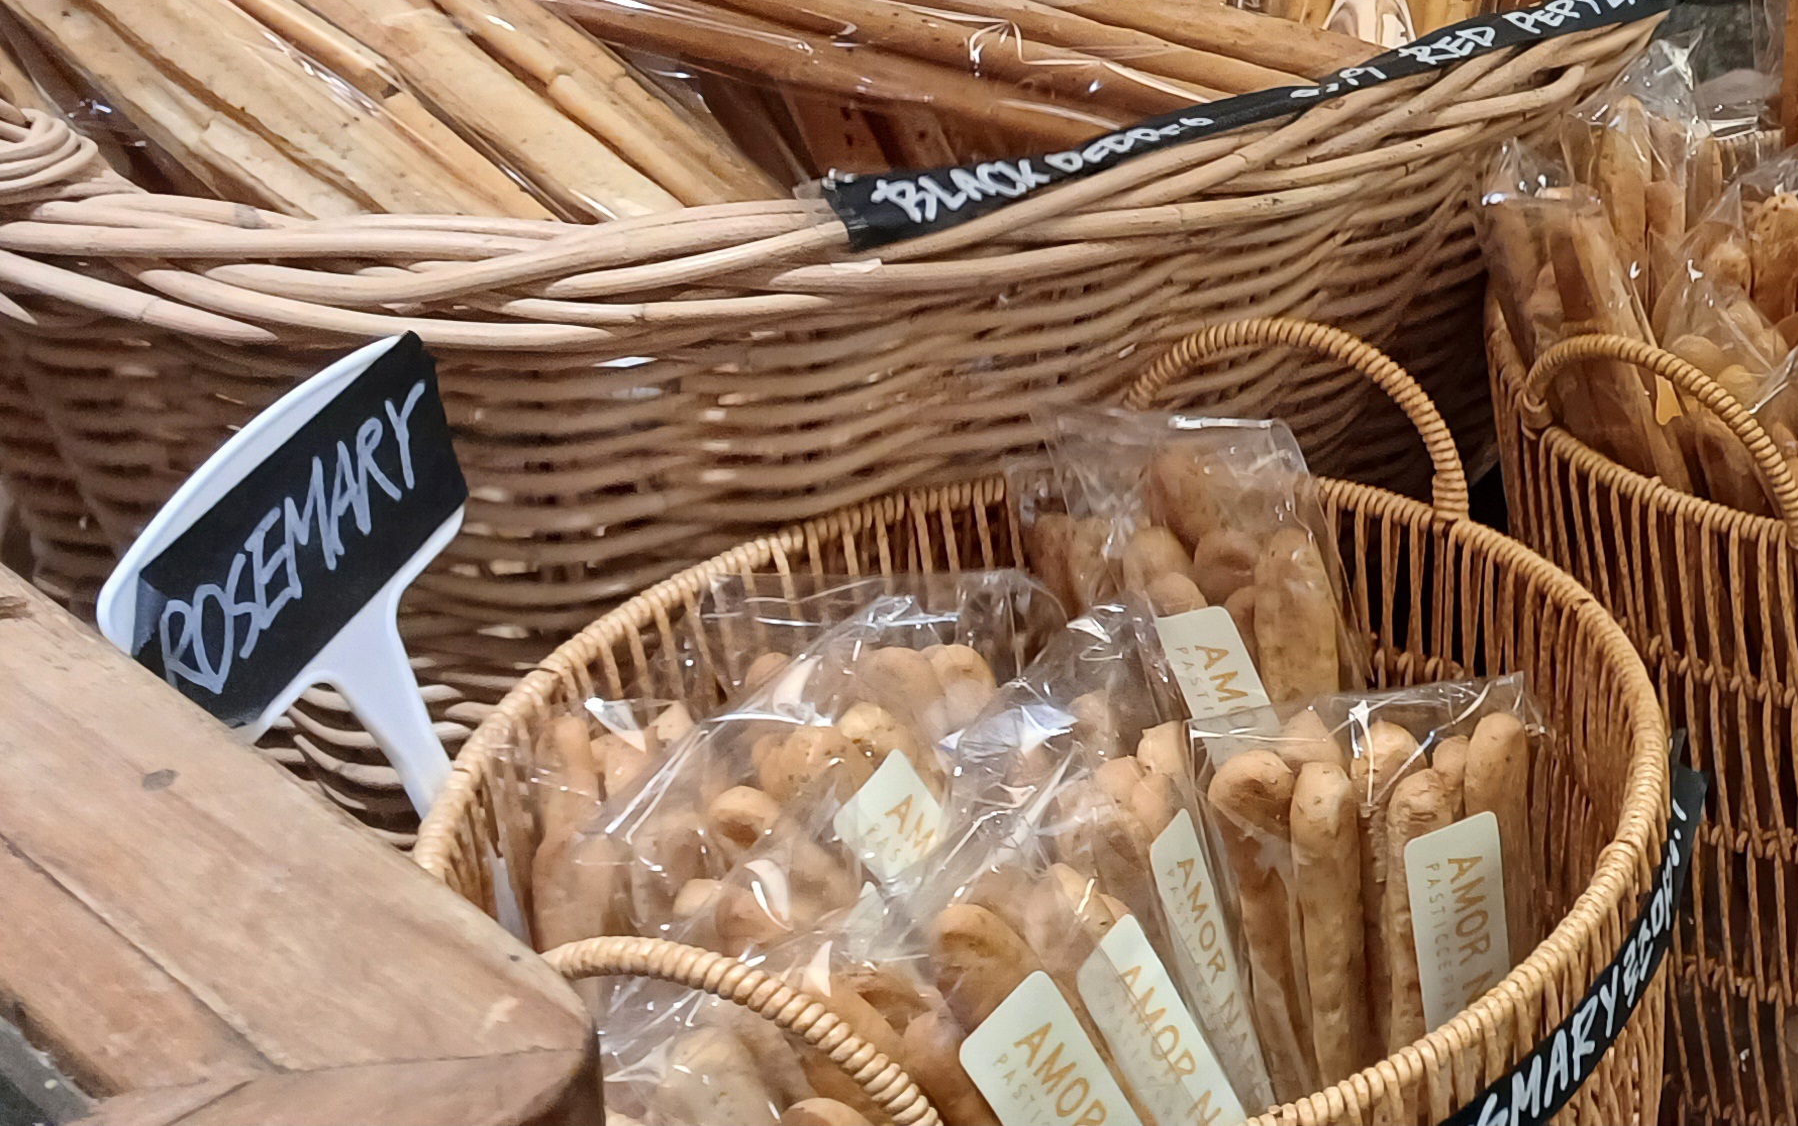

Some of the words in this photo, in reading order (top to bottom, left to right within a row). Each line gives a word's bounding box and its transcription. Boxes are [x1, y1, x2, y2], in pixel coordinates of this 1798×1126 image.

[869, 157, 1052, 224] BLACK
[1399, 26, 1497, 65] RED
[159, 379, 426, 695] ROSEMARY
[1177, 857, 1226, 985] AMOR
[1448, 855, 1492, 967] AMOR
[1013, 1021, 1107, 1126] AMOR
[1119, 965, 1196, 1077] AMOR
